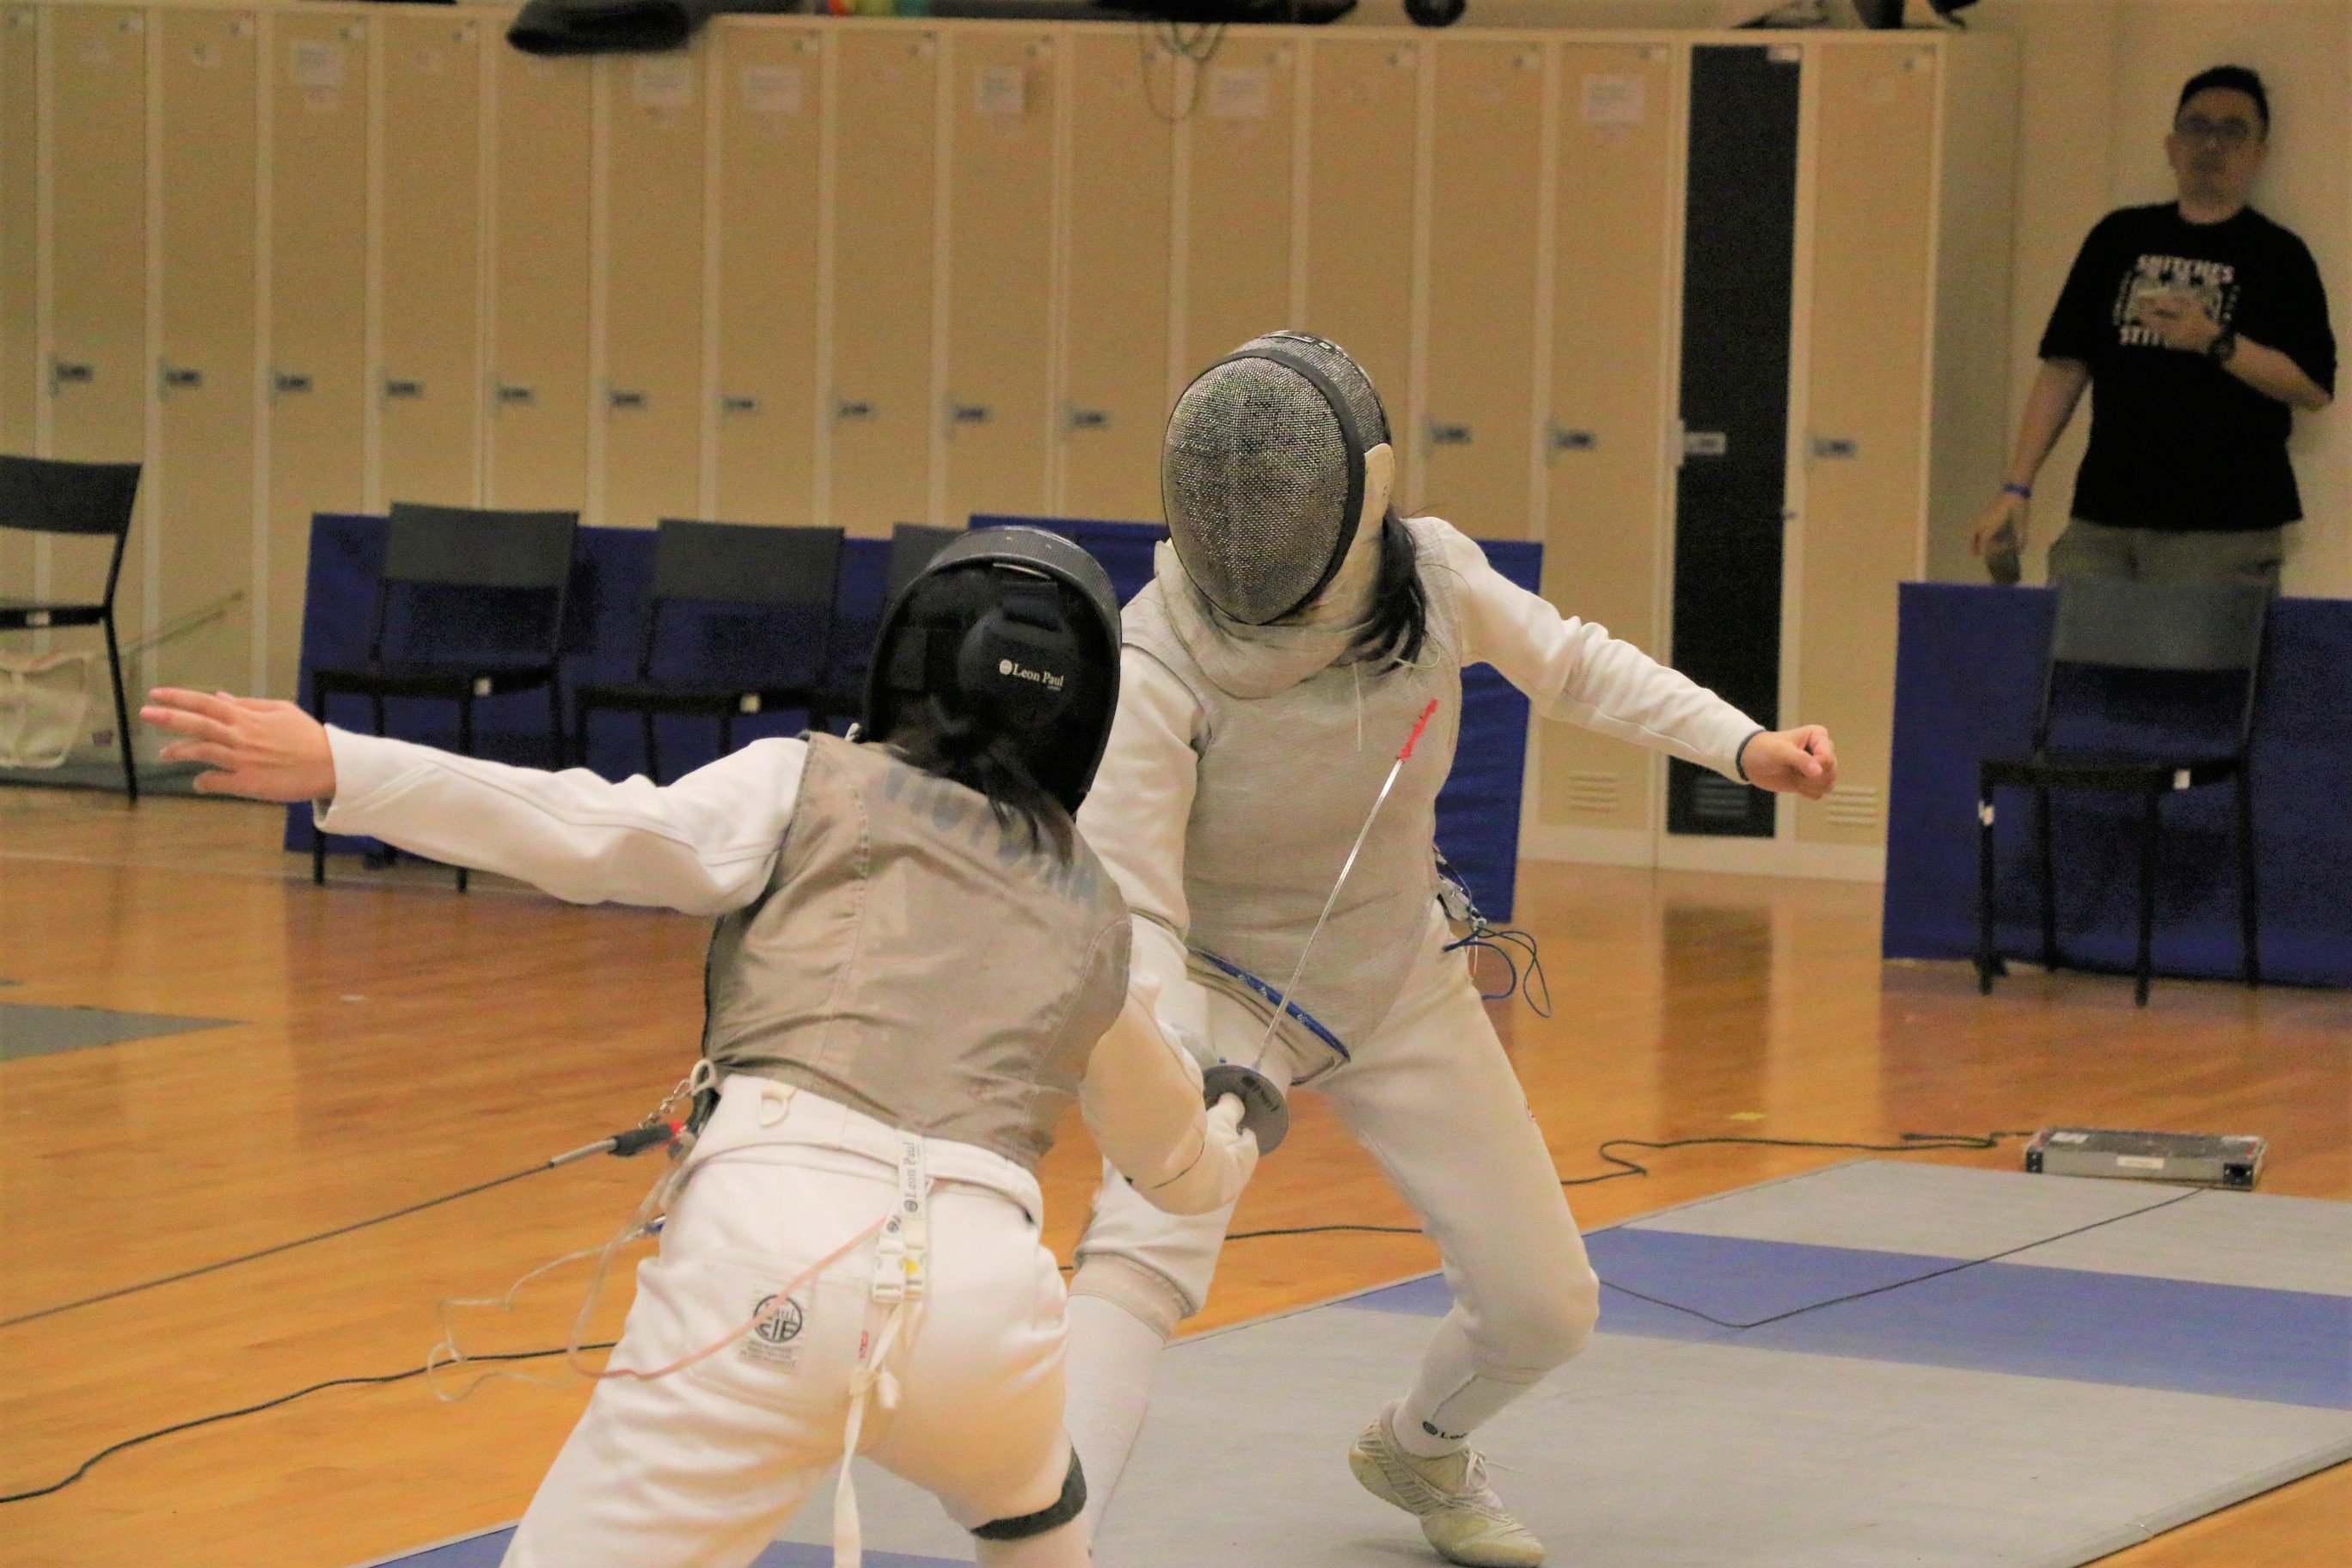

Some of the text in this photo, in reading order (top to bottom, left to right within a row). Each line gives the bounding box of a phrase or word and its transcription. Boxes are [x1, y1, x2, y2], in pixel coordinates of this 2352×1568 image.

[1014, 664, 1064, 687] Leon Paul
[903, 1141, 917, 1198] Leon Paul
